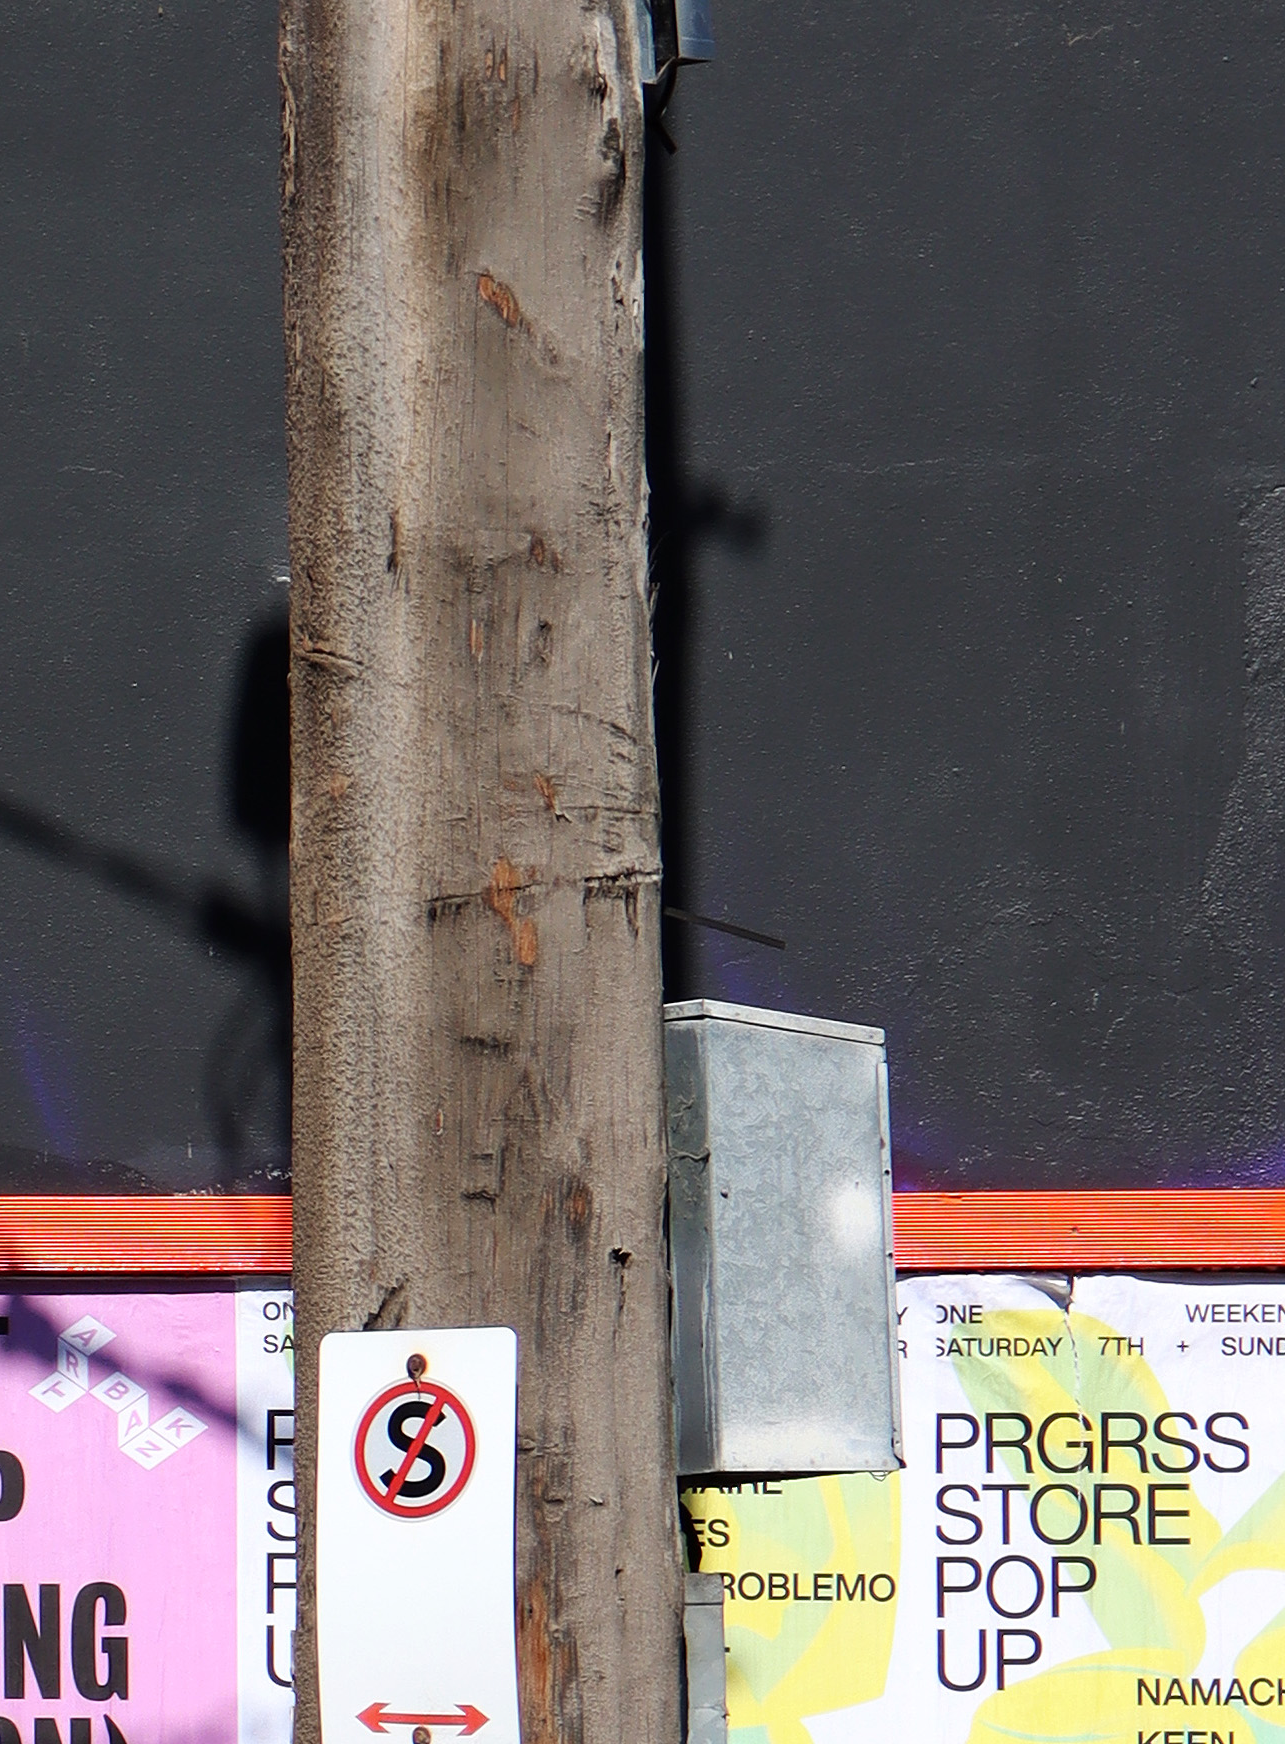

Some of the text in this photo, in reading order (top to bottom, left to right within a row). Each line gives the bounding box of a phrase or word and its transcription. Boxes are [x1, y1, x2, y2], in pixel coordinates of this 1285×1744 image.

[937, 1337, 1062, 1357] SATURDAY
[1098, 1337, 1143, 1356] 7TH
[380, 1401, 446, 1498] S
[937, 1412, 1249, 1473] PRGRSS
[937, 1484, 1190, 1545] STORE
[937, 1555, 1096, 1619] POP
[938, 1629, 1041, 1692] UP
